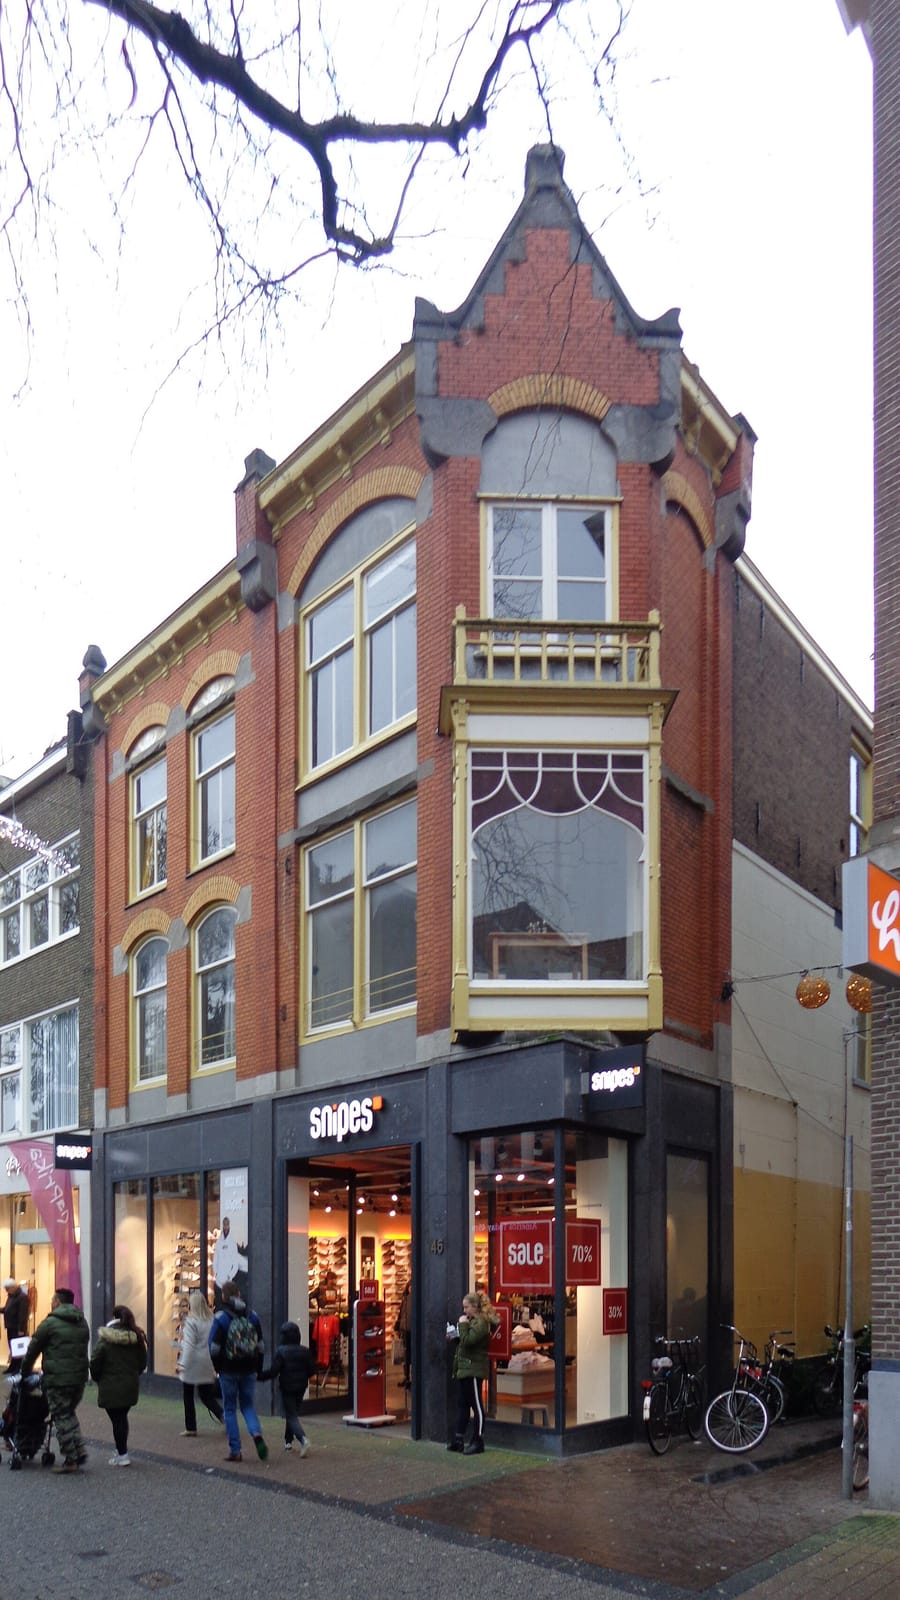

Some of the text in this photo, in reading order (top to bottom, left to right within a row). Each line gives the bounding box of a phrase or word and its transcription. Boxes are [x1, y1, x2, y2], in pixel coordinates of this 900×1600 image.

[591, 1066, 635, 1092] snipes
[310, 1097, 374, 1142] snipes
[56, 1144, 88, 1160] snipes
[431, 1239, 444, 1256] 46
[571, 1244, 593, 1263] 70%
[608, 1305, 623, 1319] 30%
